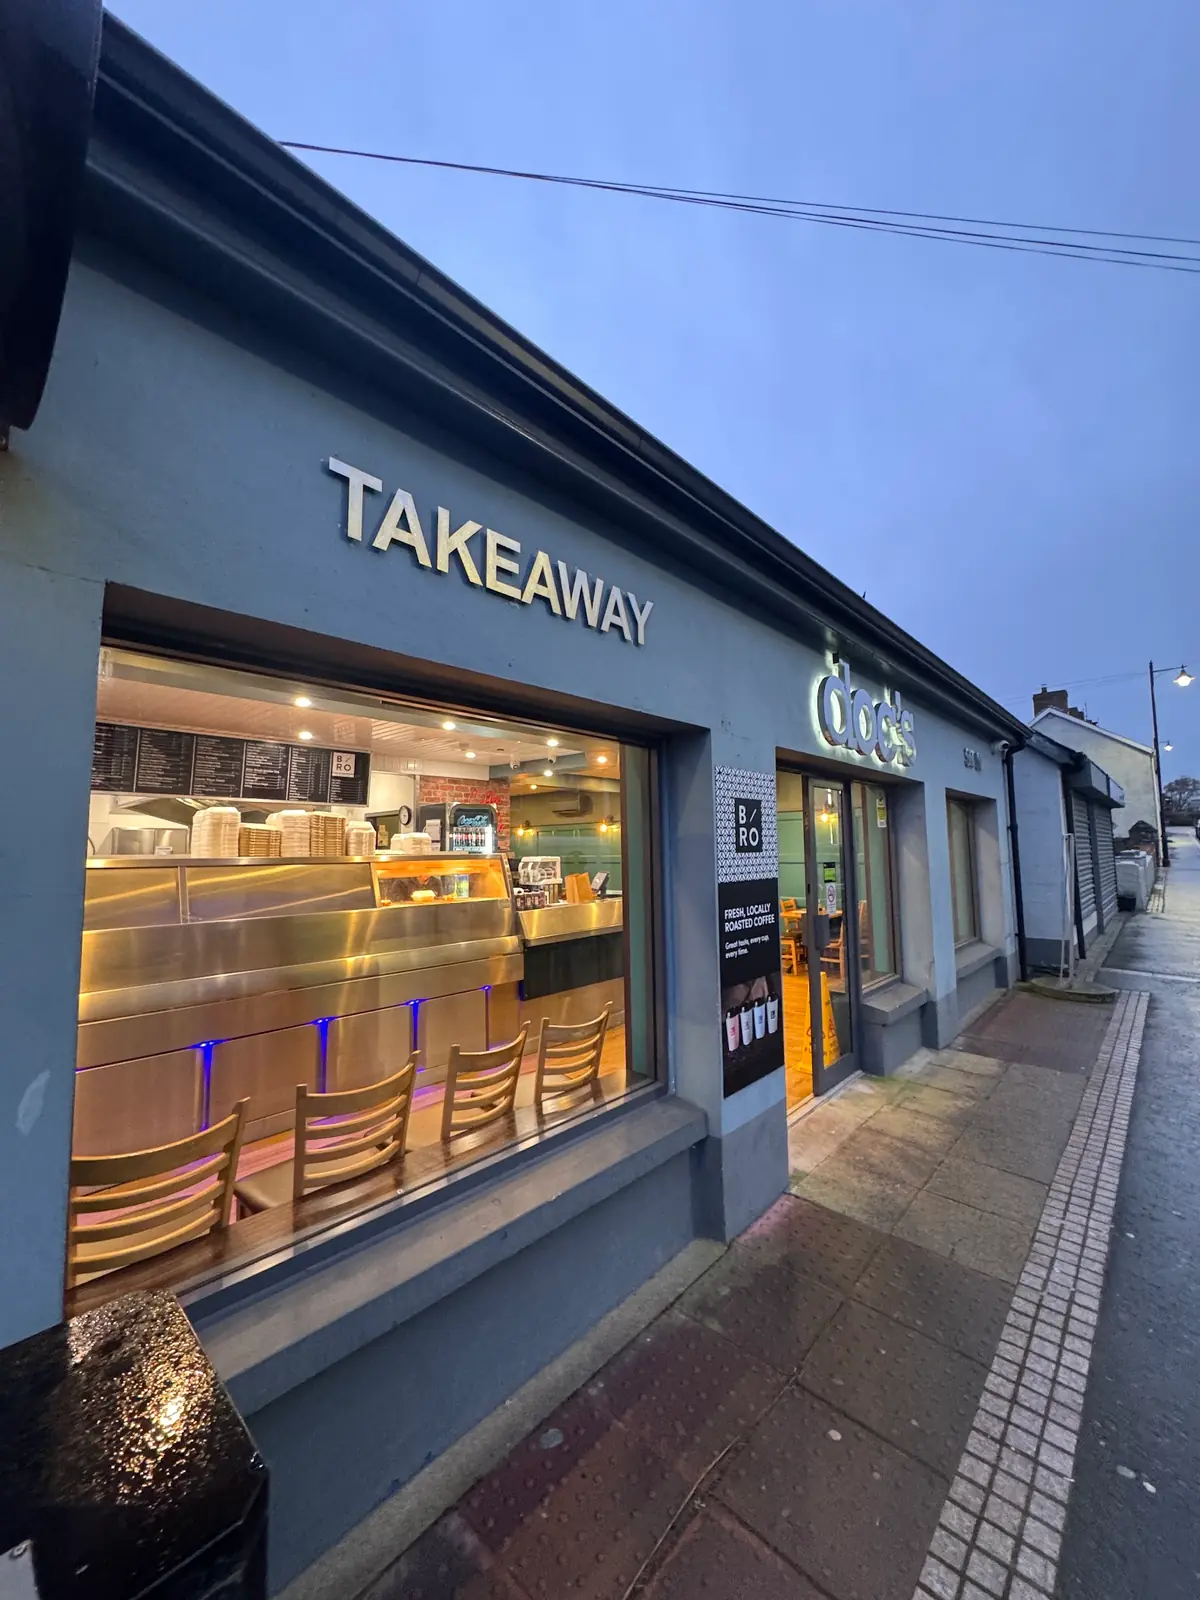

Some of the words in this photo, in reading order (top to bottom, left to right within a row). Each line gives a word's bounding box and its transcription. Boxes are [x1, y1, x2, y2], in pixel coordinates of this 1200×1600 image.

[328, 456, 654, 645] TAKEAWAY
[817, 654, 917, 768] doc's
[725, 907, 746, 919] FRESH,
[746, 903, 771, 916] LOCALLY
[725, 918, 753, 932] ROASTED
[754, 914, 775, 926] COFFEE
[725, 941, 738, 950] Great
[725, 950, 738, 959] every
